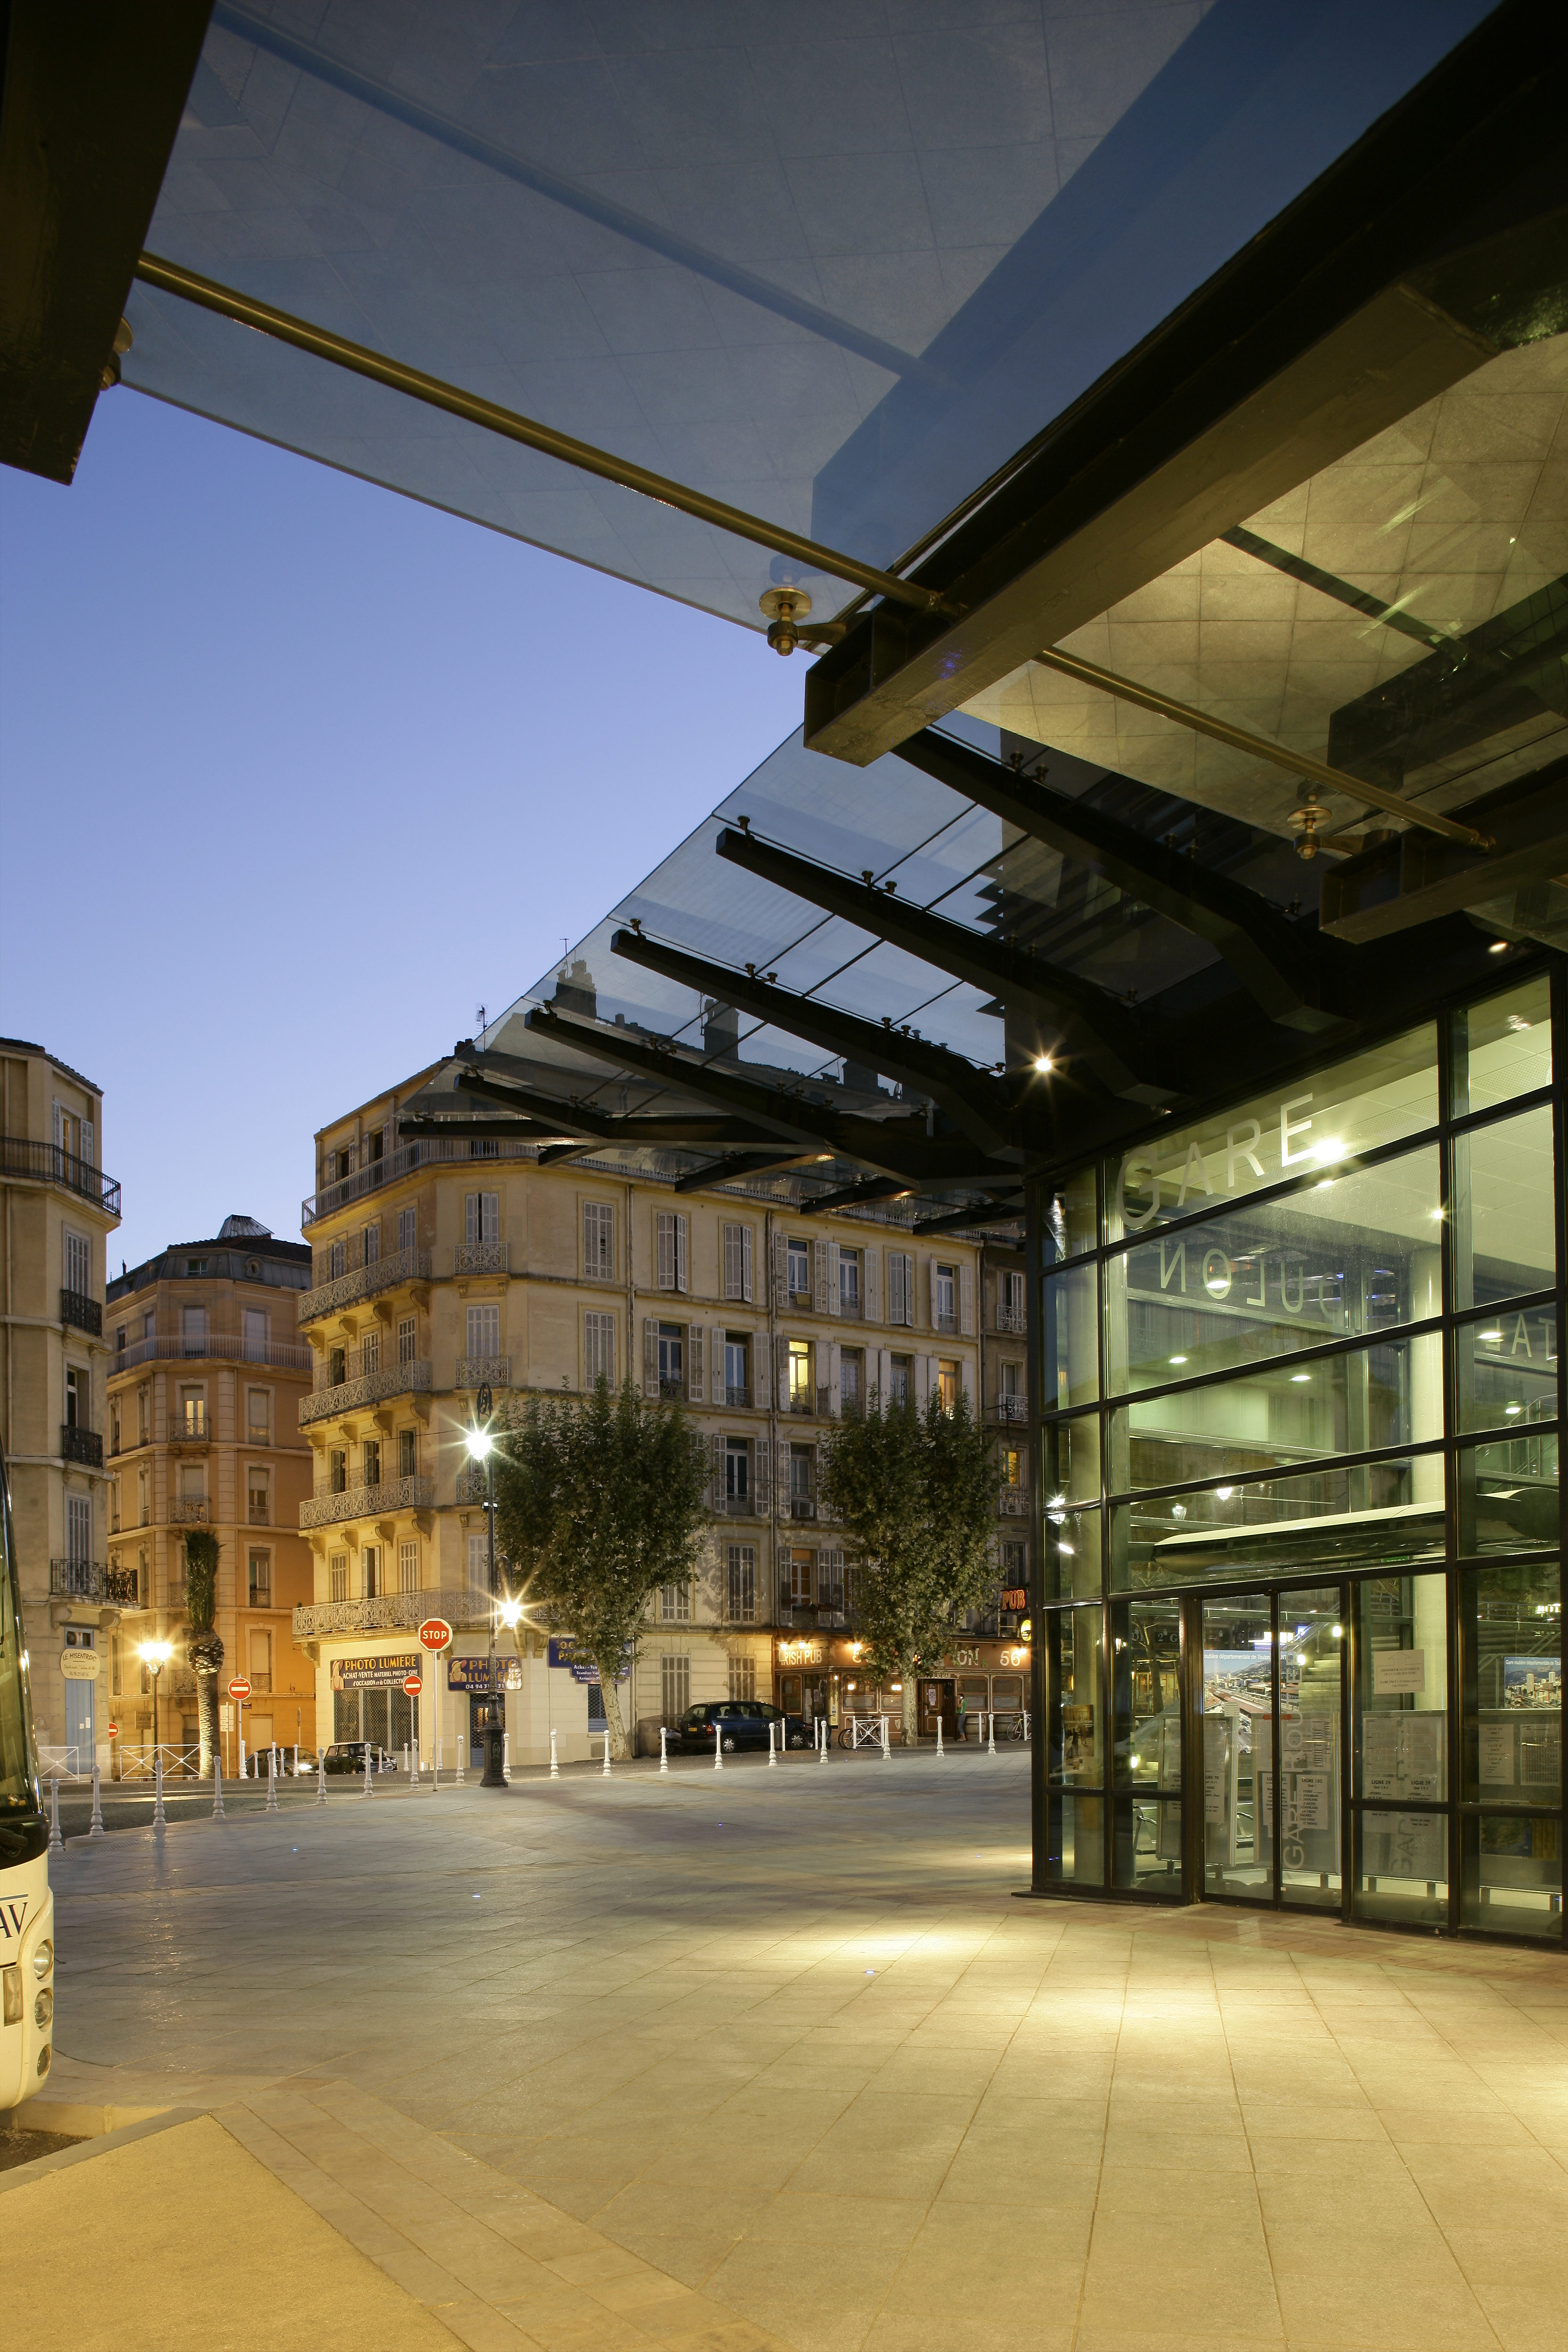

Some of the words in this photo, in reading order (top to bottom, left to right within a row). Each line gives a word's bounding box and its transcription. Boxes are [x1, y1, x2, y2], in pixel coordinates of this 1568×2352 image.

[1116, 1093, 1324, 1227] GARE
[1002, 1590, 1026, 1610] PUB
[423, 1631, 447, 1640] STOP
[345, 1659, 376, 1671] PHOTO
[379, 1656, 416, 1668] LUMIERE
[781, 1650, 802, 1666] RISH
[804, 1649, 822, 1665] PUB
[1000, 1650, 1021, 1666] 56
[469, 1672, 517, 1682] LUMERE
